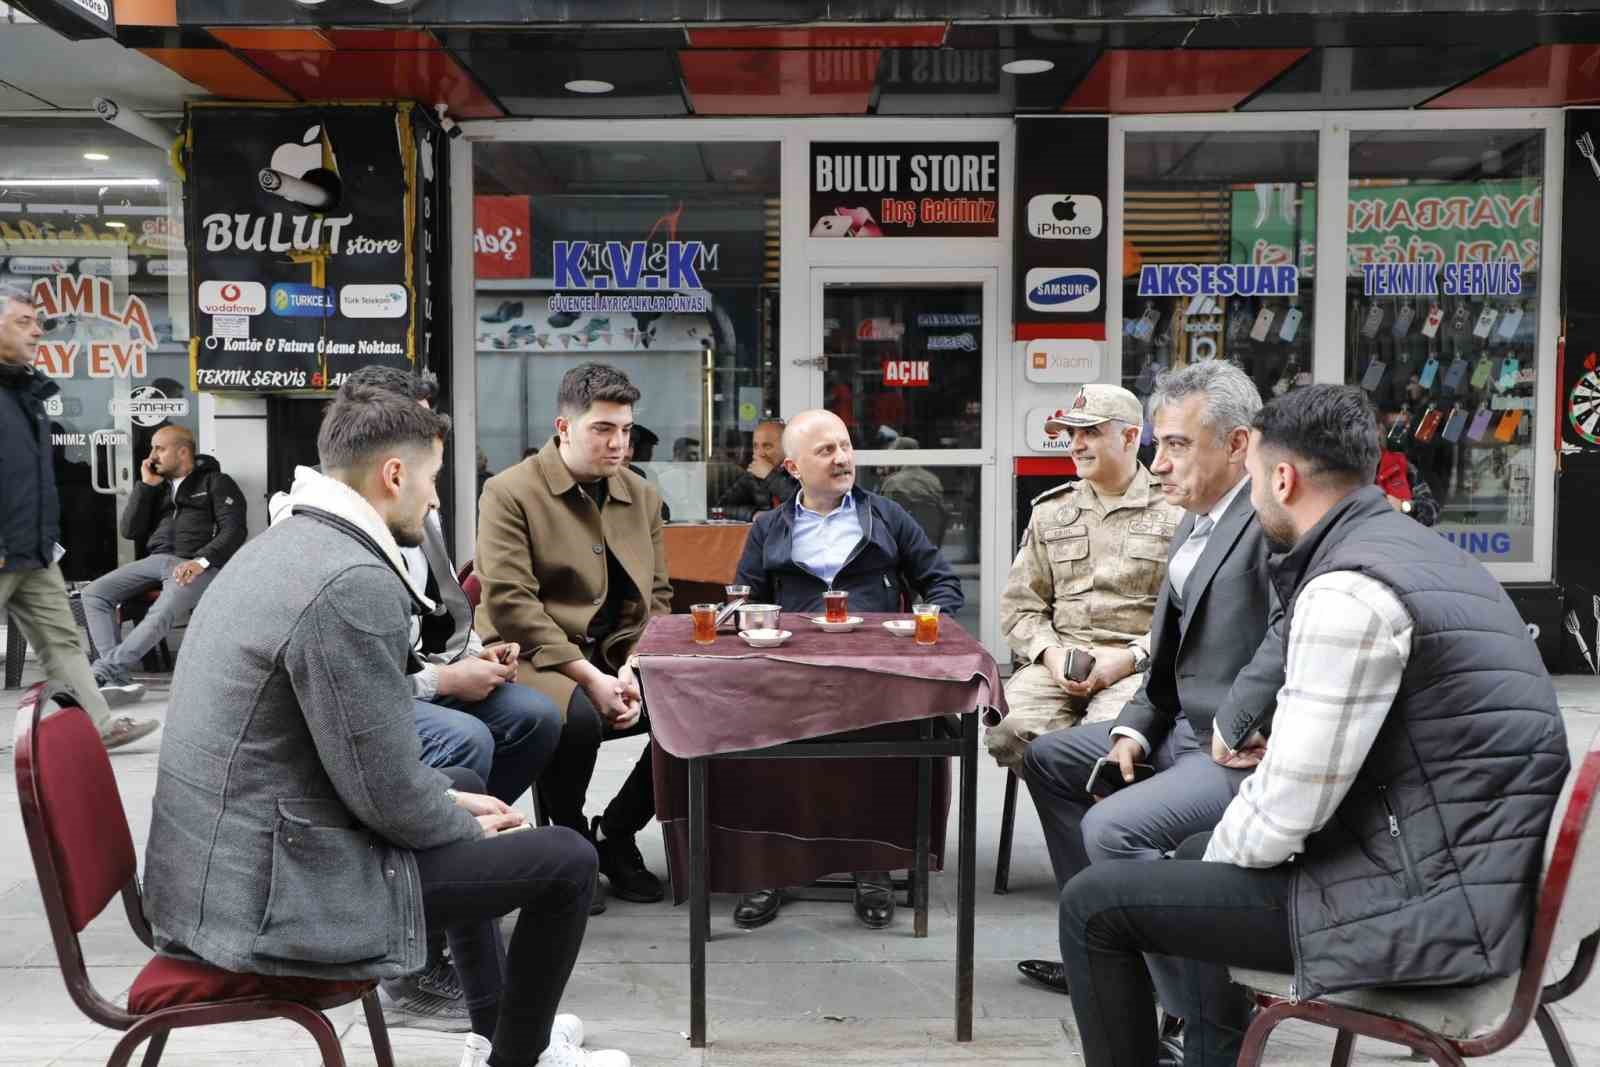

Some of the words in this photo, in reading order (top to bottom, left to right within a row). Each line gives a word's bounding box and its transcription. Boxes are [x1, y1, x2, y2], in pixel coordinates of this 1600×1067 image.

[816, 155, 900, 192] BULUT
[910, 155, 996, 192] STORE
[881, 198, 916, 228] Hoş
[921, 198, 995, 223] Geldiniz
[203, 212, 353, 254] BULUT
[346, 235, 401, 256] store
[1037, 223, 1092, 236] iPhone
[552, 240, 703, 289] K.V.K
[1361, 256, 1439, 296] TEKNİK
[1444, 256, 1523, 296] SERVİS
[1037, 283, 1090, 297] SAMSUNG
[1137, 264, 1299, 297] AKSESUAR
[31, 273, 158, 350] AMLA
[206, 304, 257, 313] vodafone
[289, 294, 334, 308] TURKCEL
[33, 340, 79, 377] AY
[223, 338, 263, 352] Kontör
[277, 339, 315, 353] Fatura
[886, 360, 929, 385] AÇIK
[50, 433, 86, 446] INIMIZ
